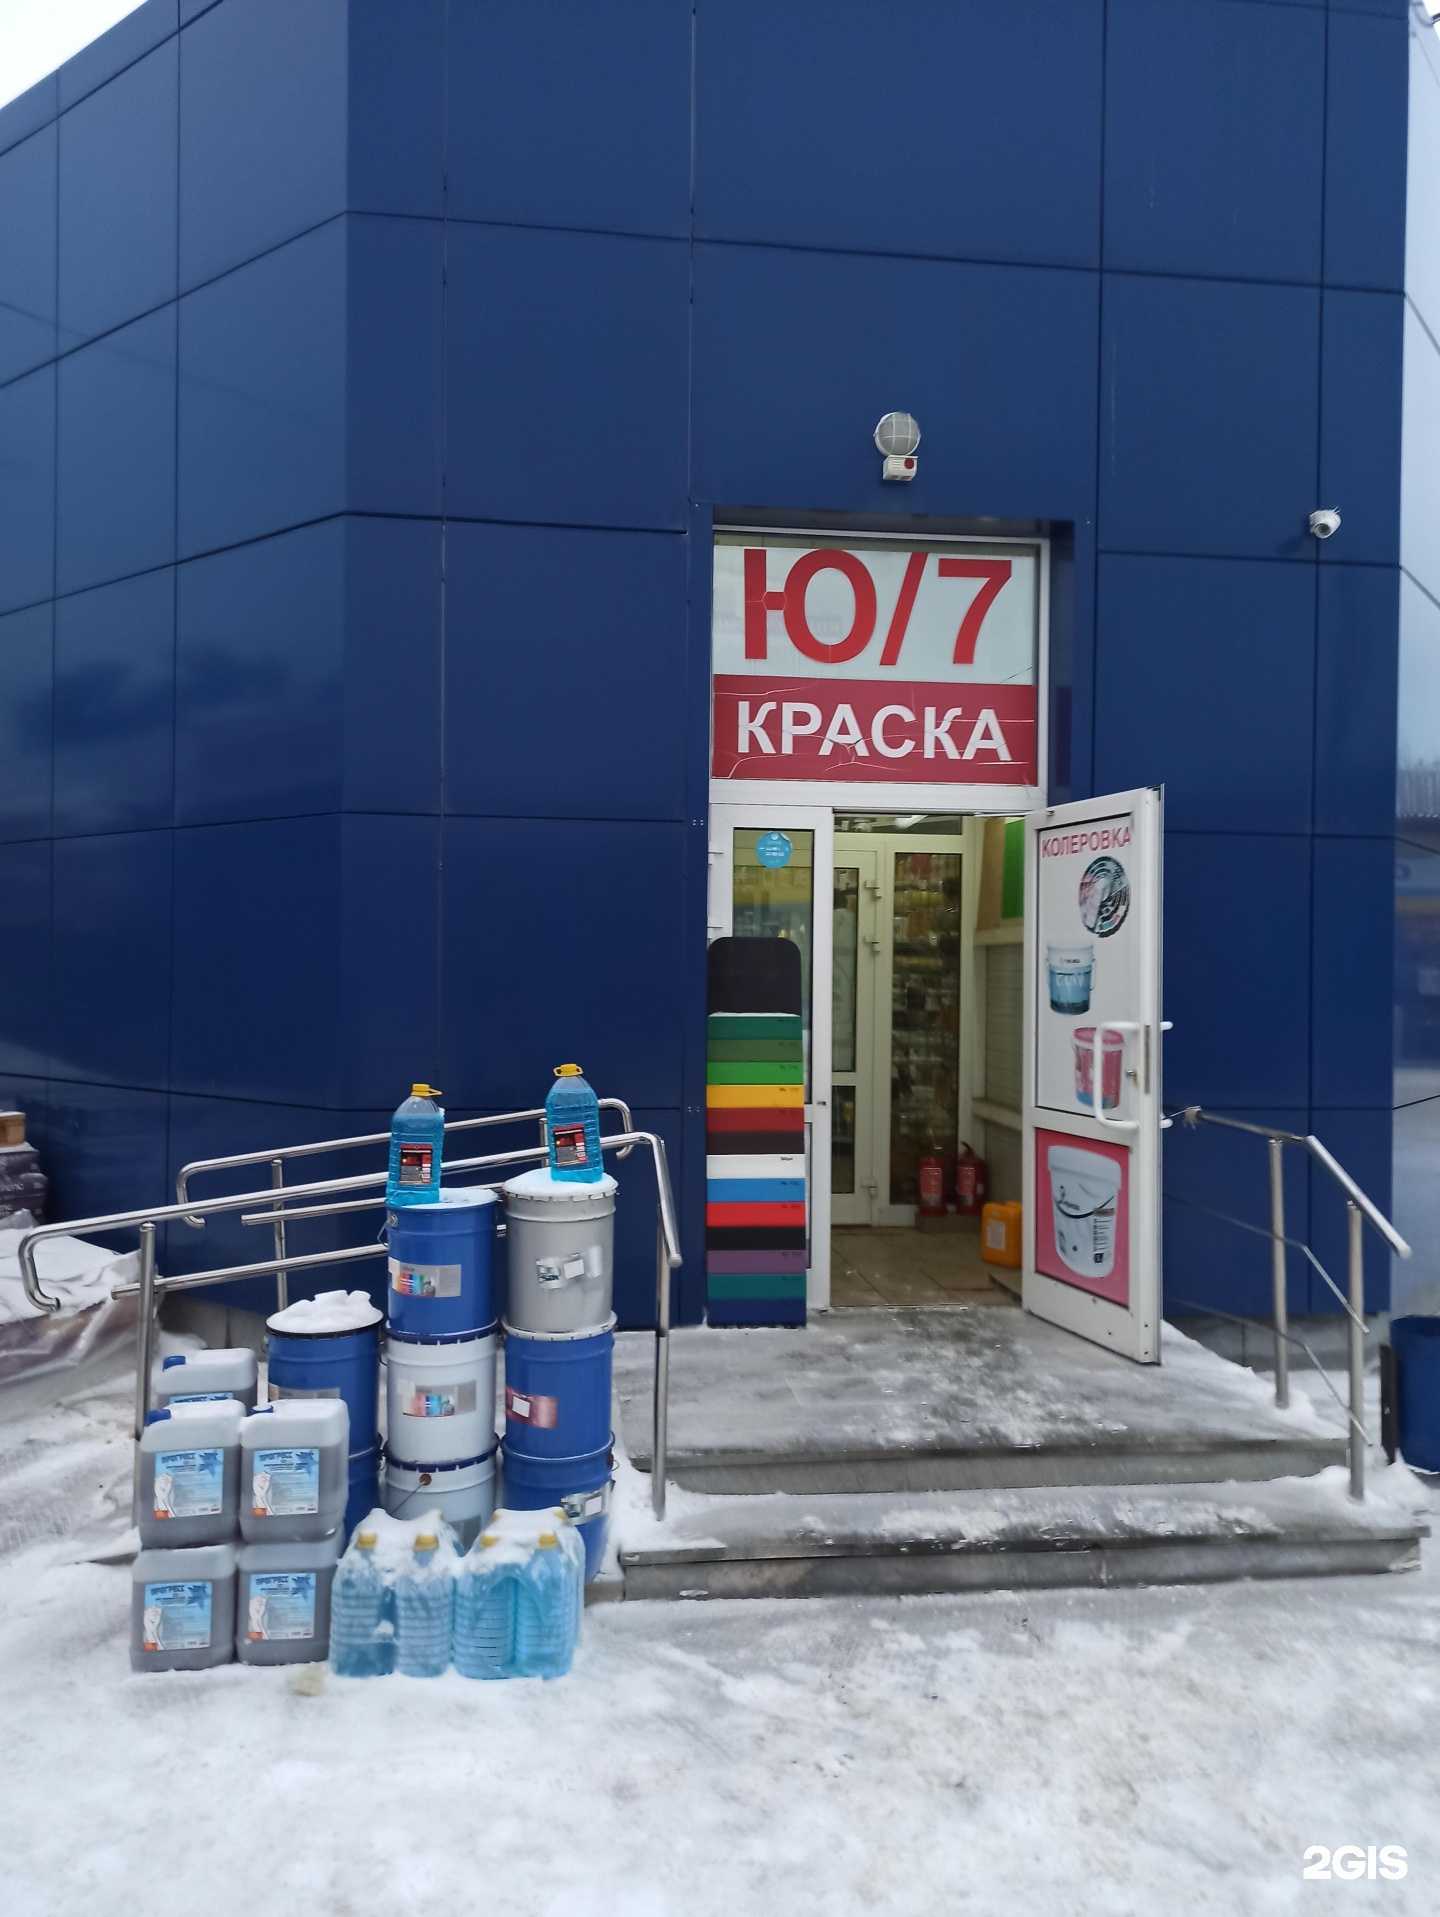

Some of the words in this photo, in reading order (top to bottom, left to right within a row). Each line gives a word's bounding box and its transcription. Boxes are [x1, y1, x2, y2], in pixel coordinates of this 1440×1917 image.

[744, 548, 1012, 666] Ю/7
[737, 700, 1012, 761] КРАСКА
[1041, 826, 1132, 858] КОЛЕРОВКА
